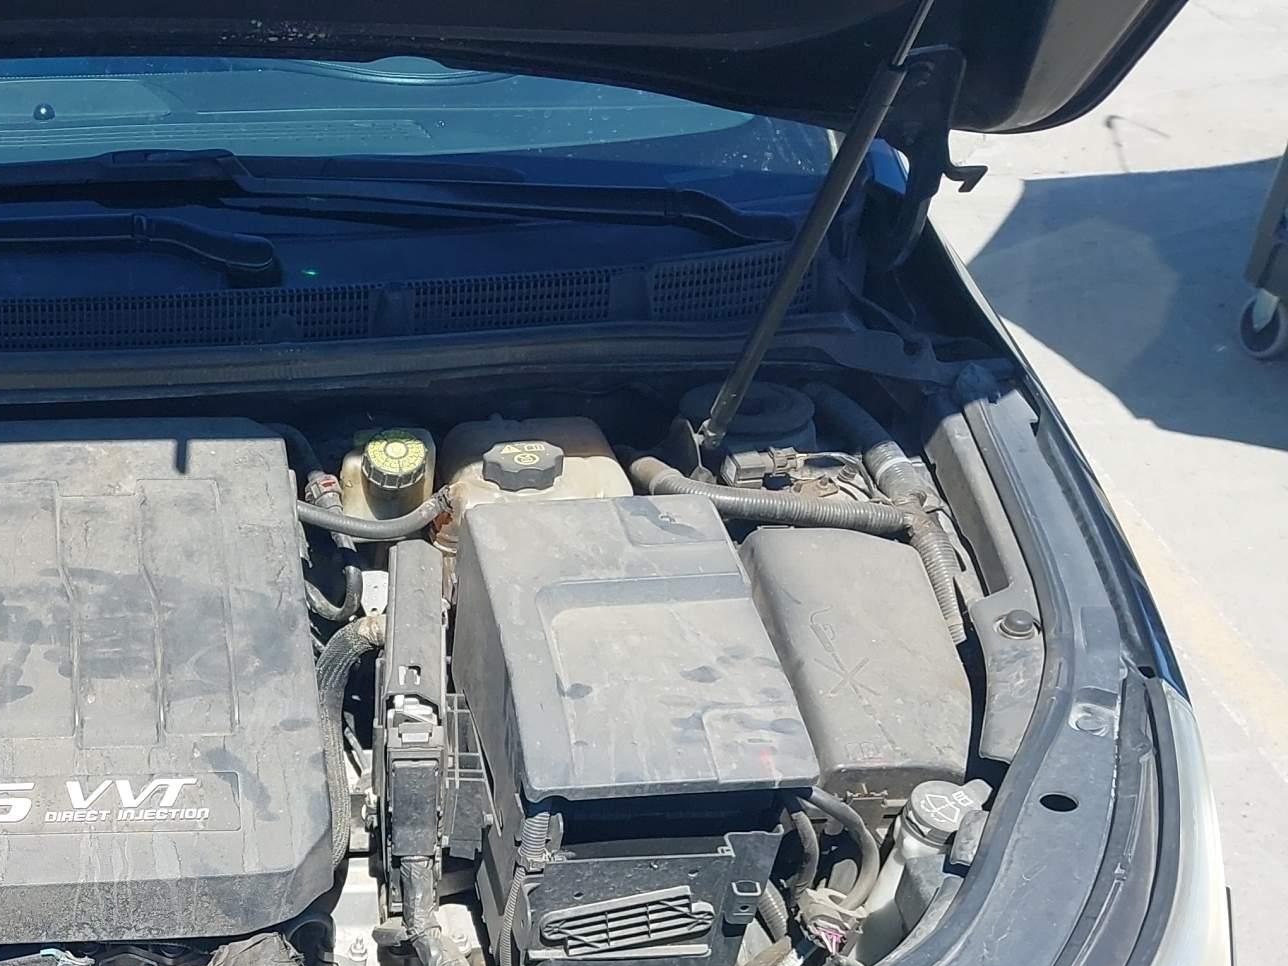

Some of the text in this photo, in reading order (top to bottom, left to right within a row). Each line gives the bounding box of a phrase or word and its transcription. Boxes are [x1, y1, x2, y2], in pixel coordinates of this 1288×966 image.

[65, 777, 198, 809] VVT
[44, 807, 210, 823] DIRECT INJECTION
